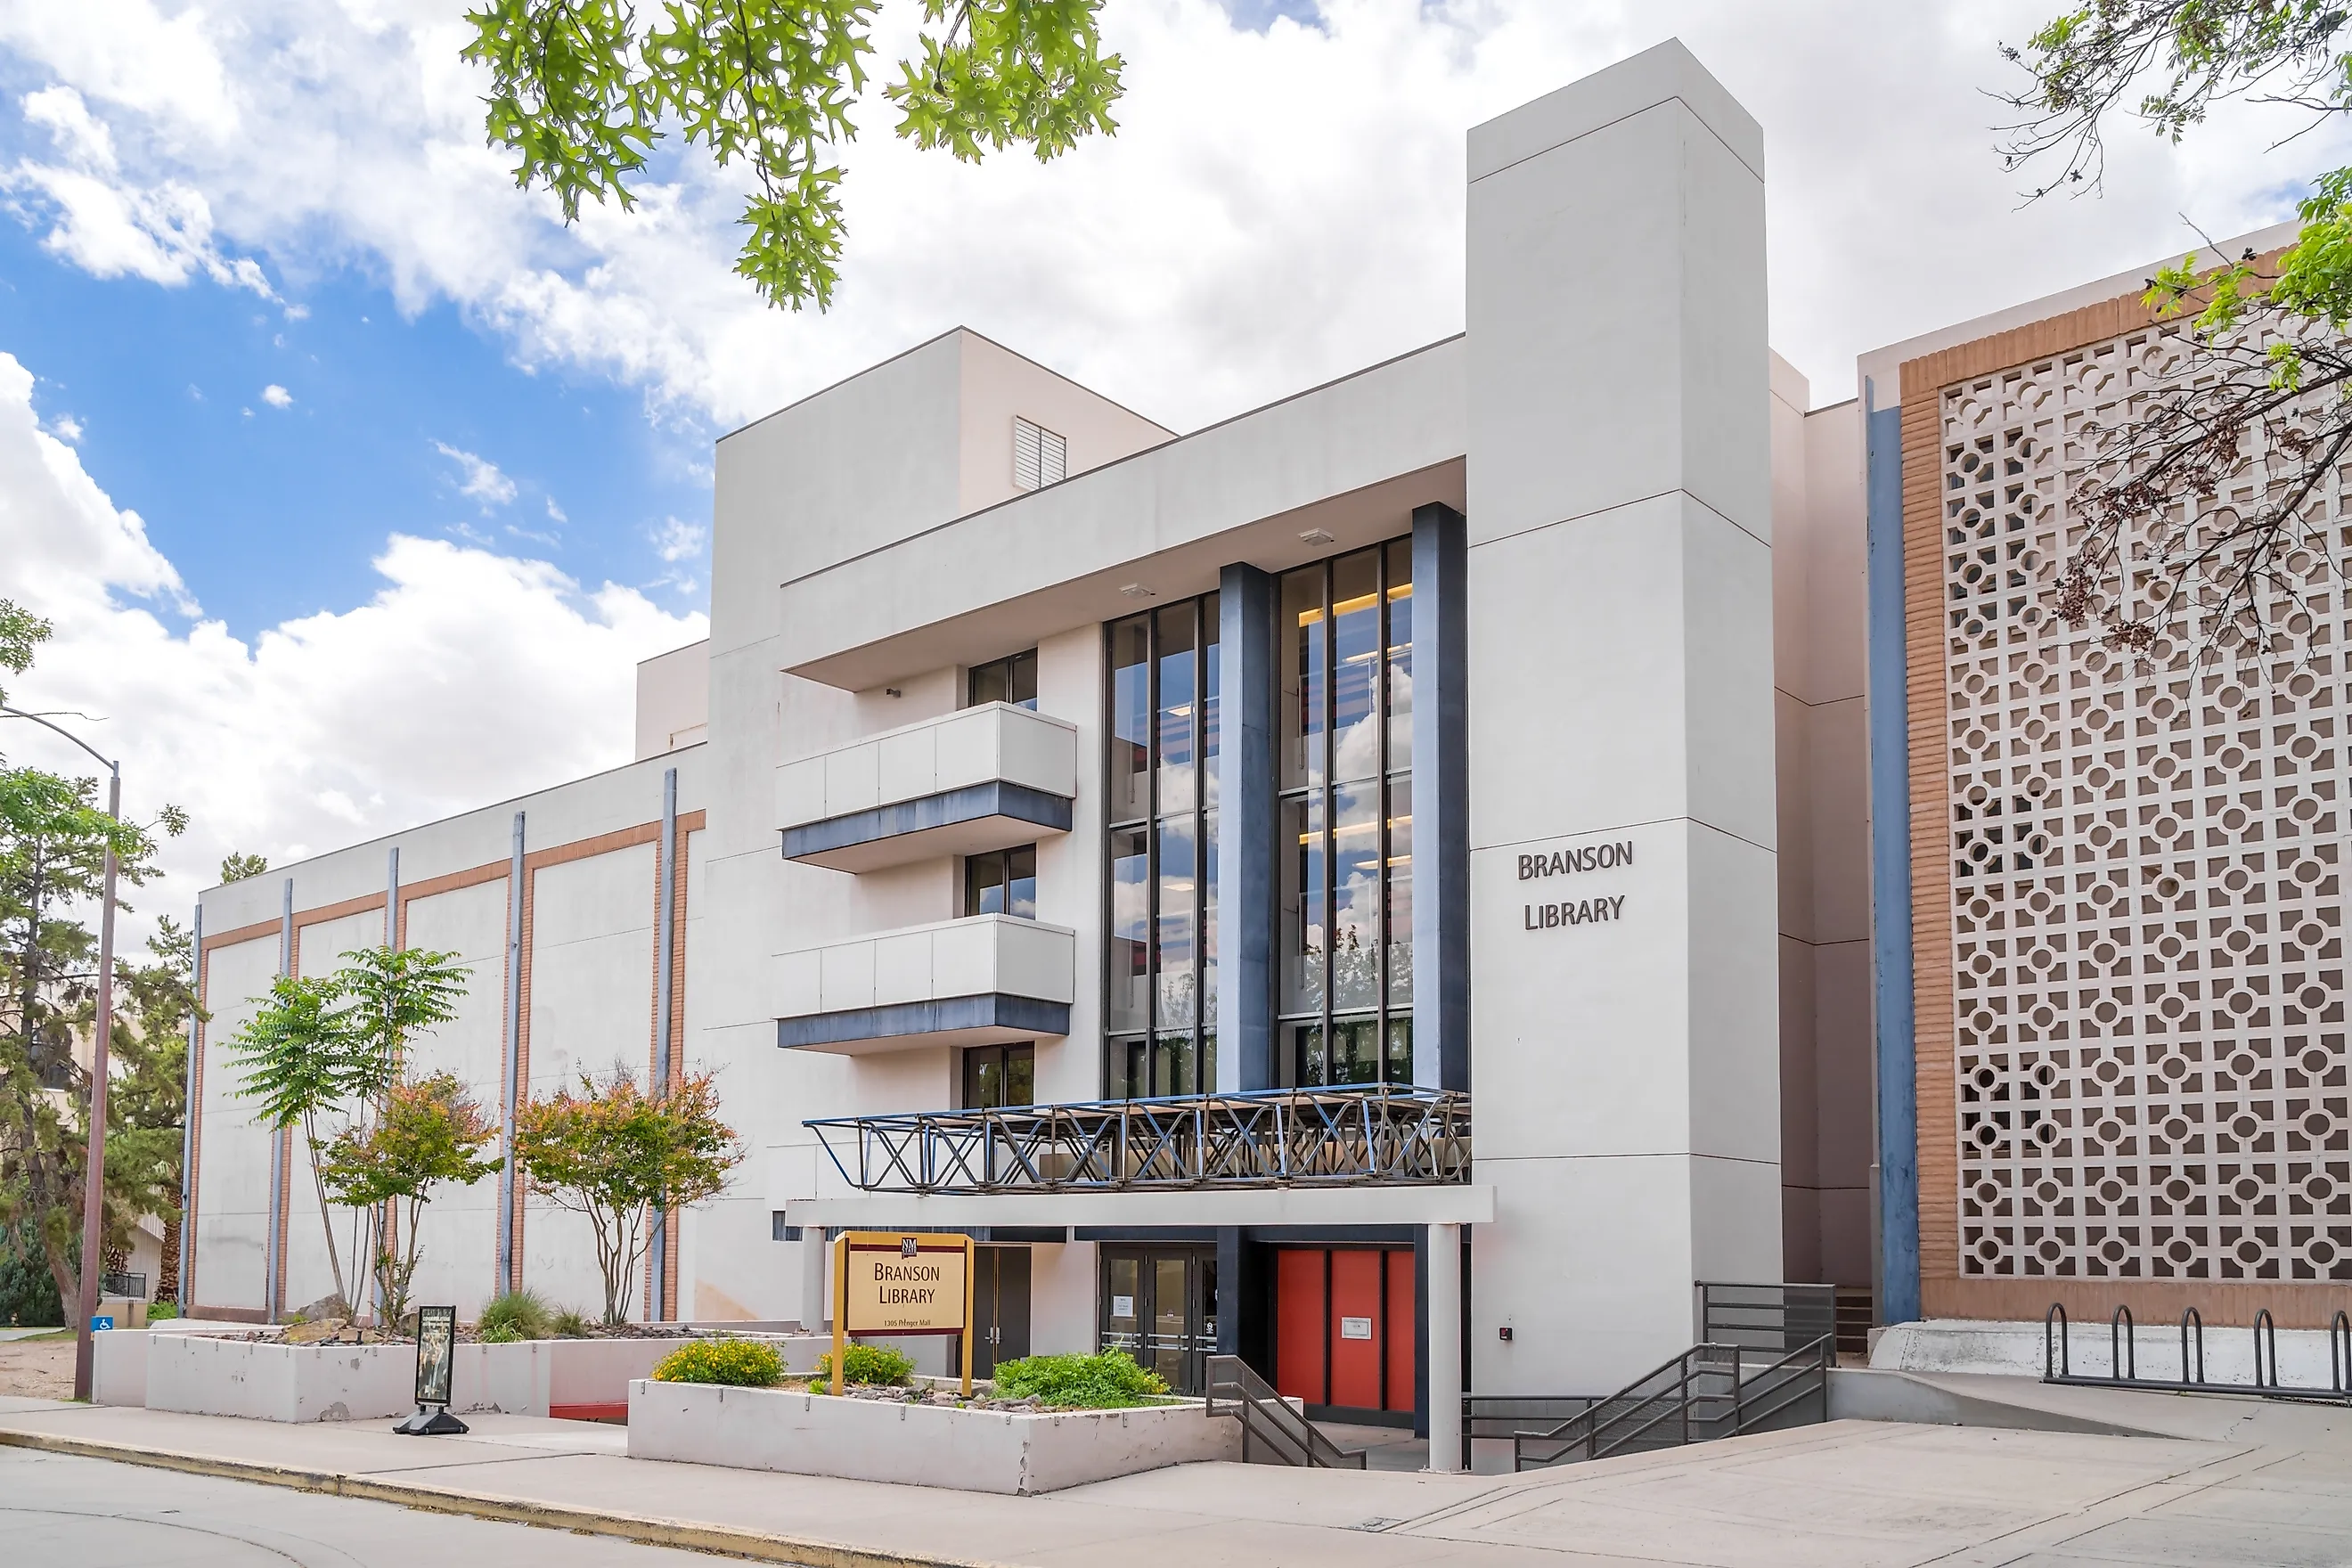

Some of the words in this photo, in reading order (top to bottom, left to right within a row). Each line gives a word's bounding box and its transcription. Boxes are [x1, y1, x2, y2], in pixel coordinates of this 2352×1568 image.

[1518, 841, 1632, 880] BRANSON
[1524, 894, 1625, 930] LIBRARY
[902, 1238, 917, 1248] NM
[874, 1262, 940, 1281] BRANSON
[879, 1286, 935, 1304] LIBRARY
